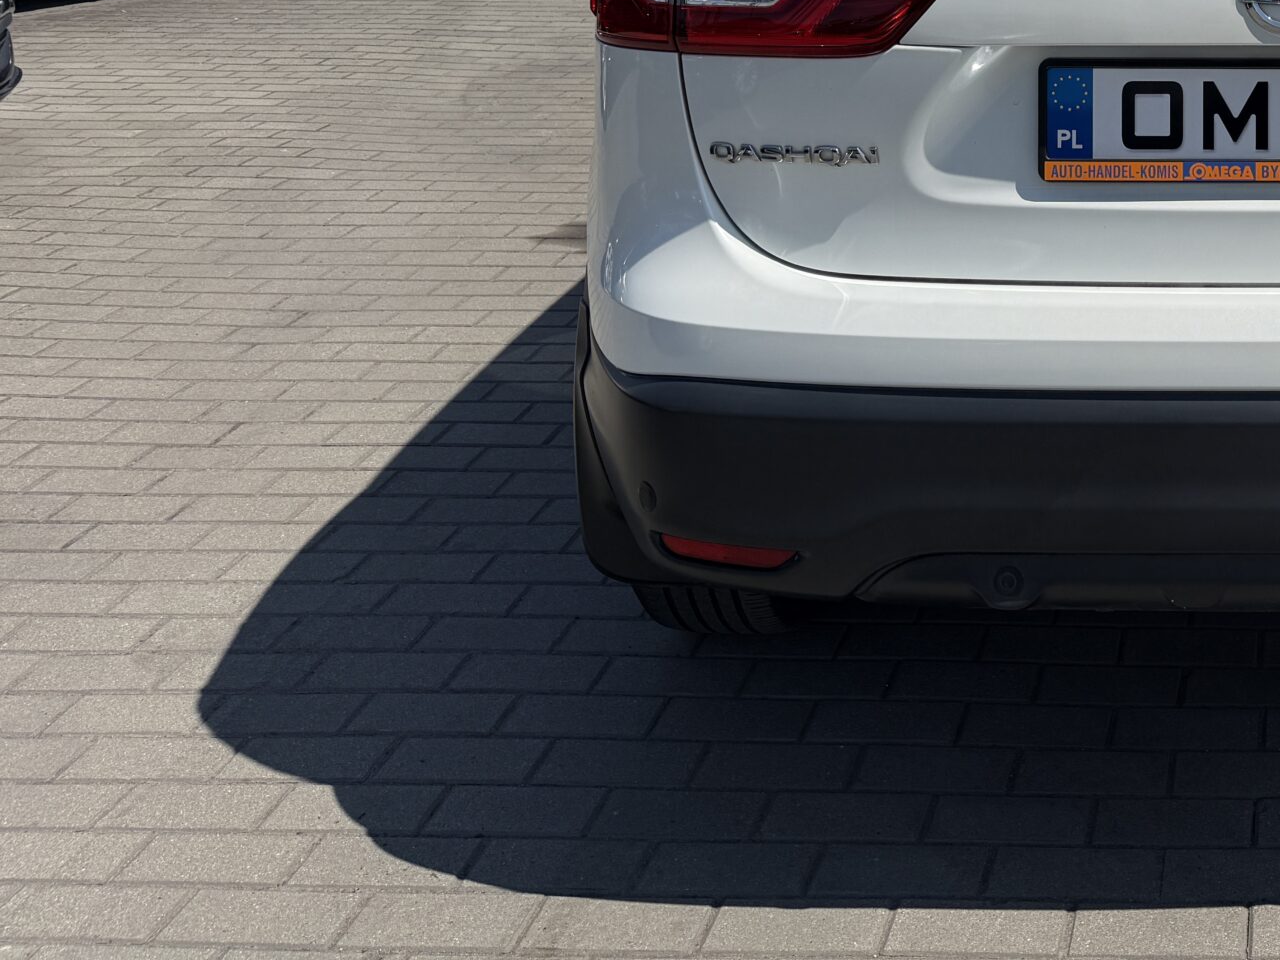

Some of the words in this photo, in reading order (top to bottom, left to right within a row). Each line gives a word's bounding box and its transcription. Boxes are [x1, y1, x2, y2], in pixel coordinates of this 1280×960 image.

[1057, 129, 1083, 150] PL
[709, 141, 880, 167] QASHQAI
[1051, 164, 1179, 179] AUTO-HANDEL-KOMIS
